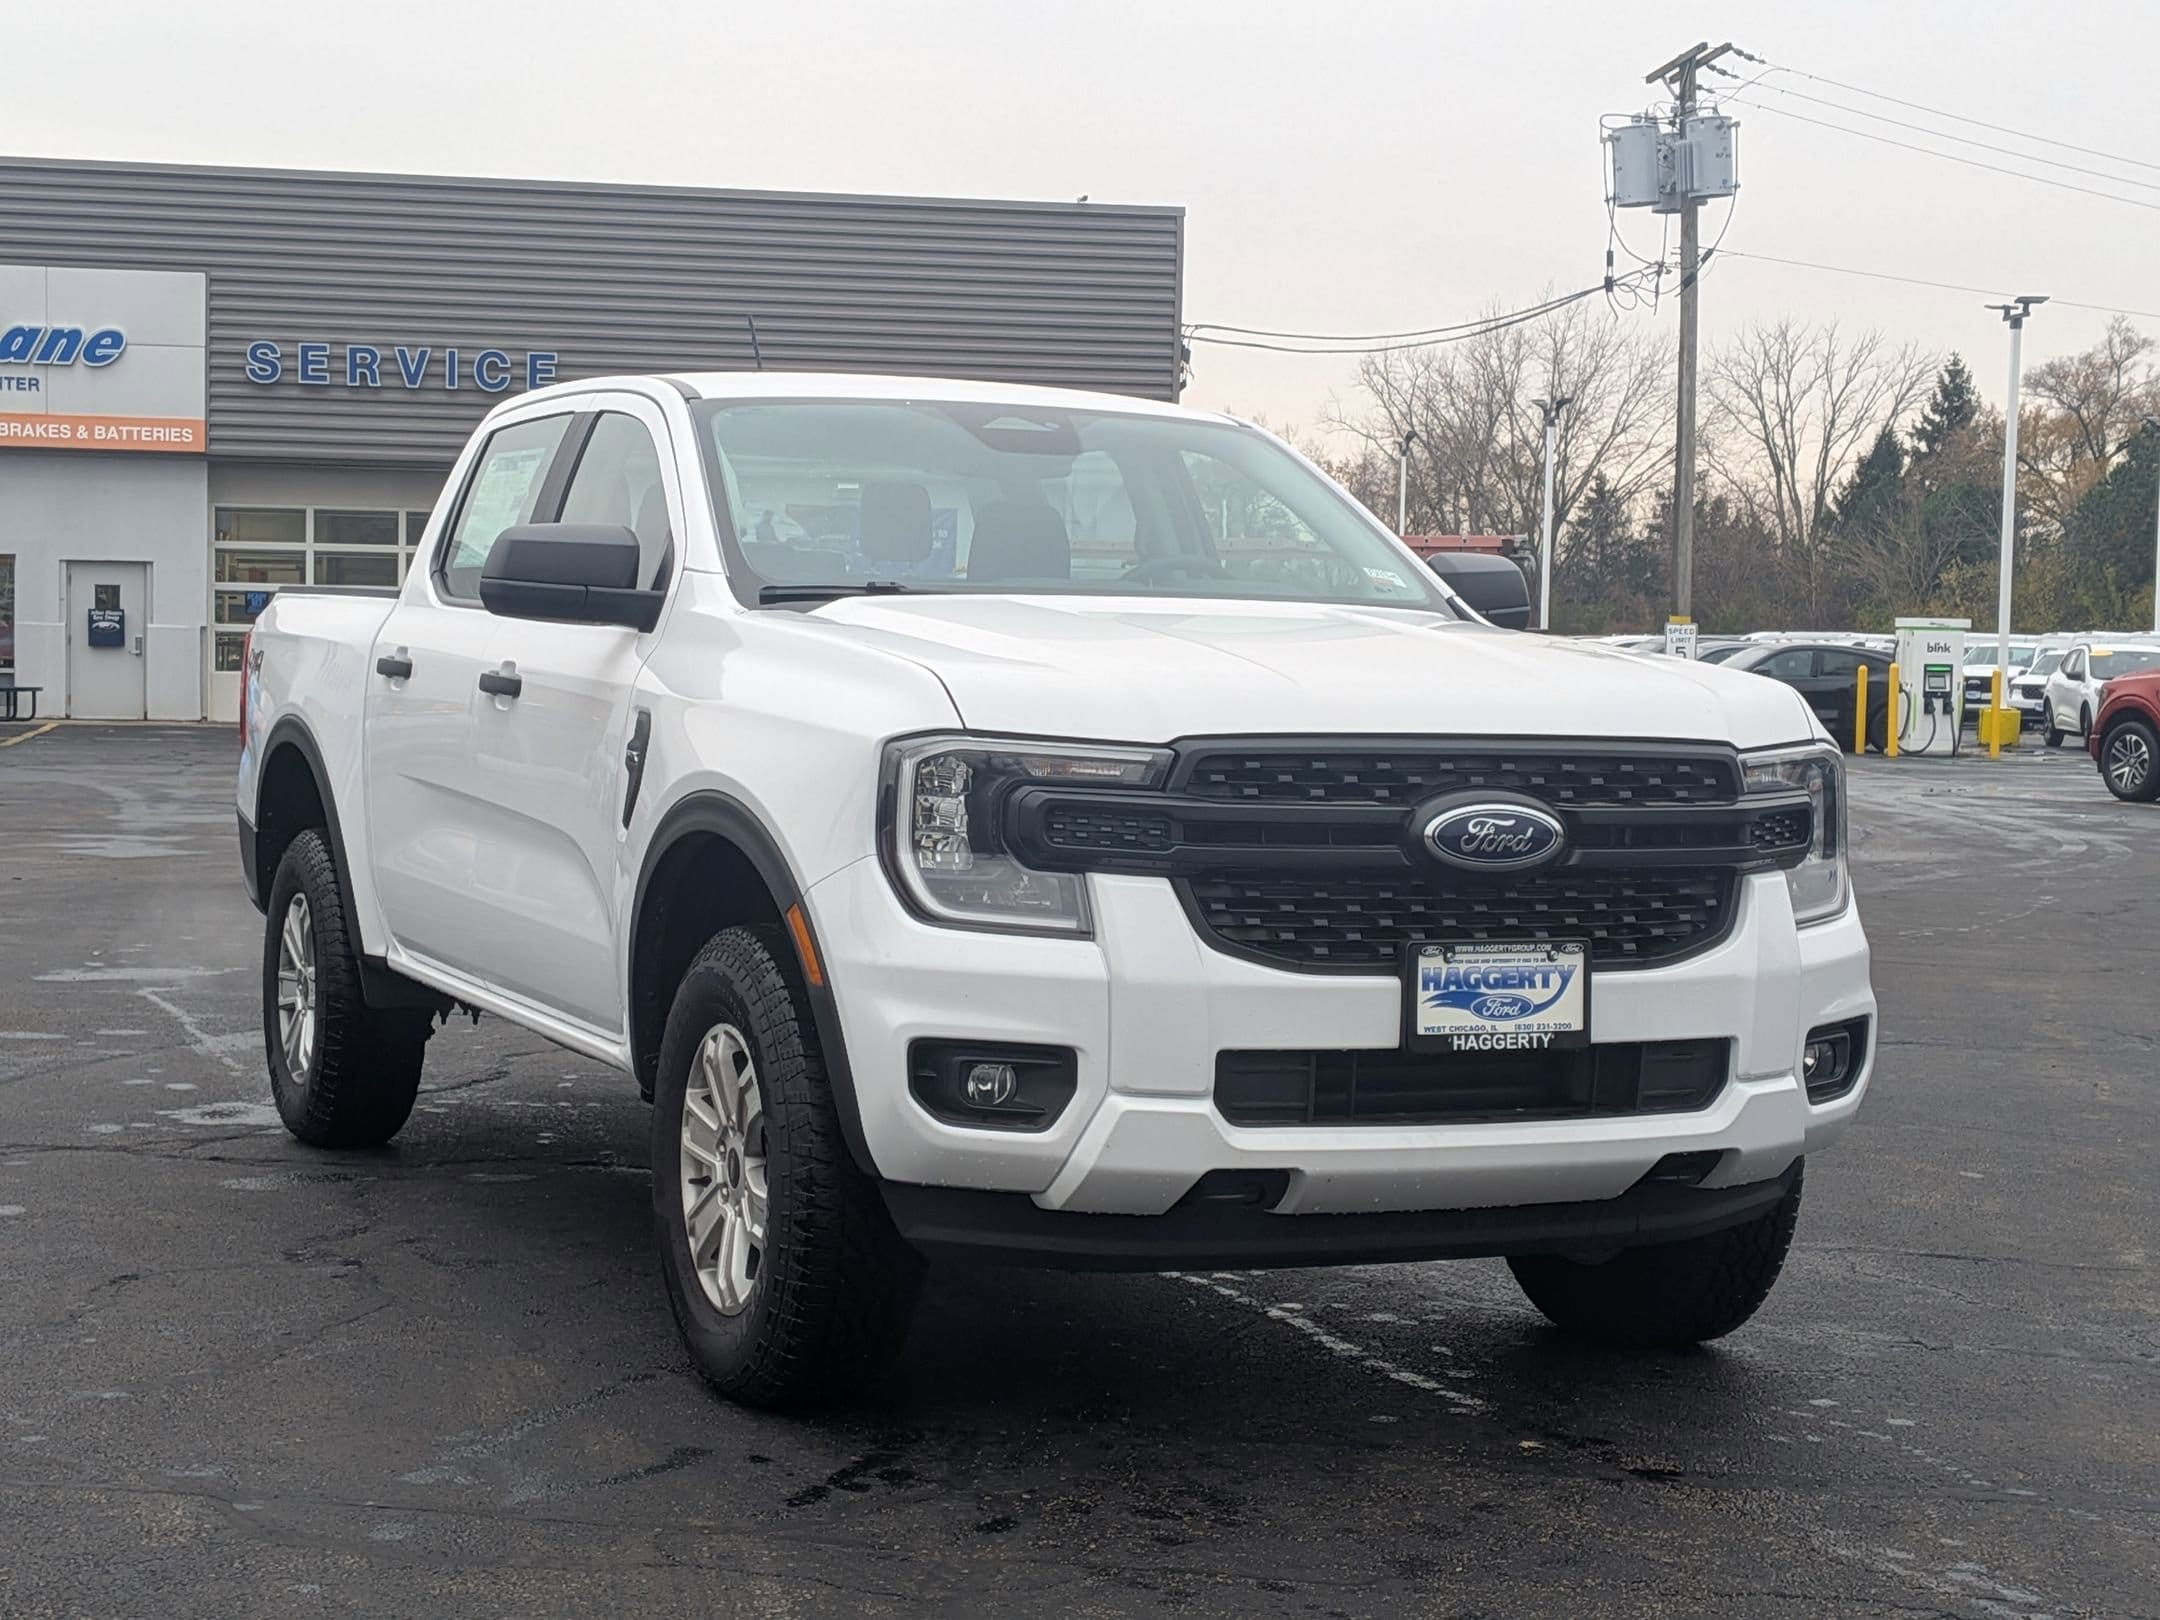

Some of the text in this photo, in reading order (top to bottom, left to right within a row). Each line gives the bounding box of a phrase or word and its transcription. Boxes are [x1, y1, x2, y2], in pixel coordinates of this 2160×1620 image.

[245, 340, 558, 393] SERVICE
[0, 422, 193, 442] BRAKES & BATTERIES
[1926, 642, 1951, 653] blink
[1460, 817, 1534, 852] Ford
[1454, 943, 1553, 953] WWW.HAGGERTYGROUP.COM
[1421, 964, 1577, 991] HAGGERTY
[1482, 998, 1521, 1017] Ford
